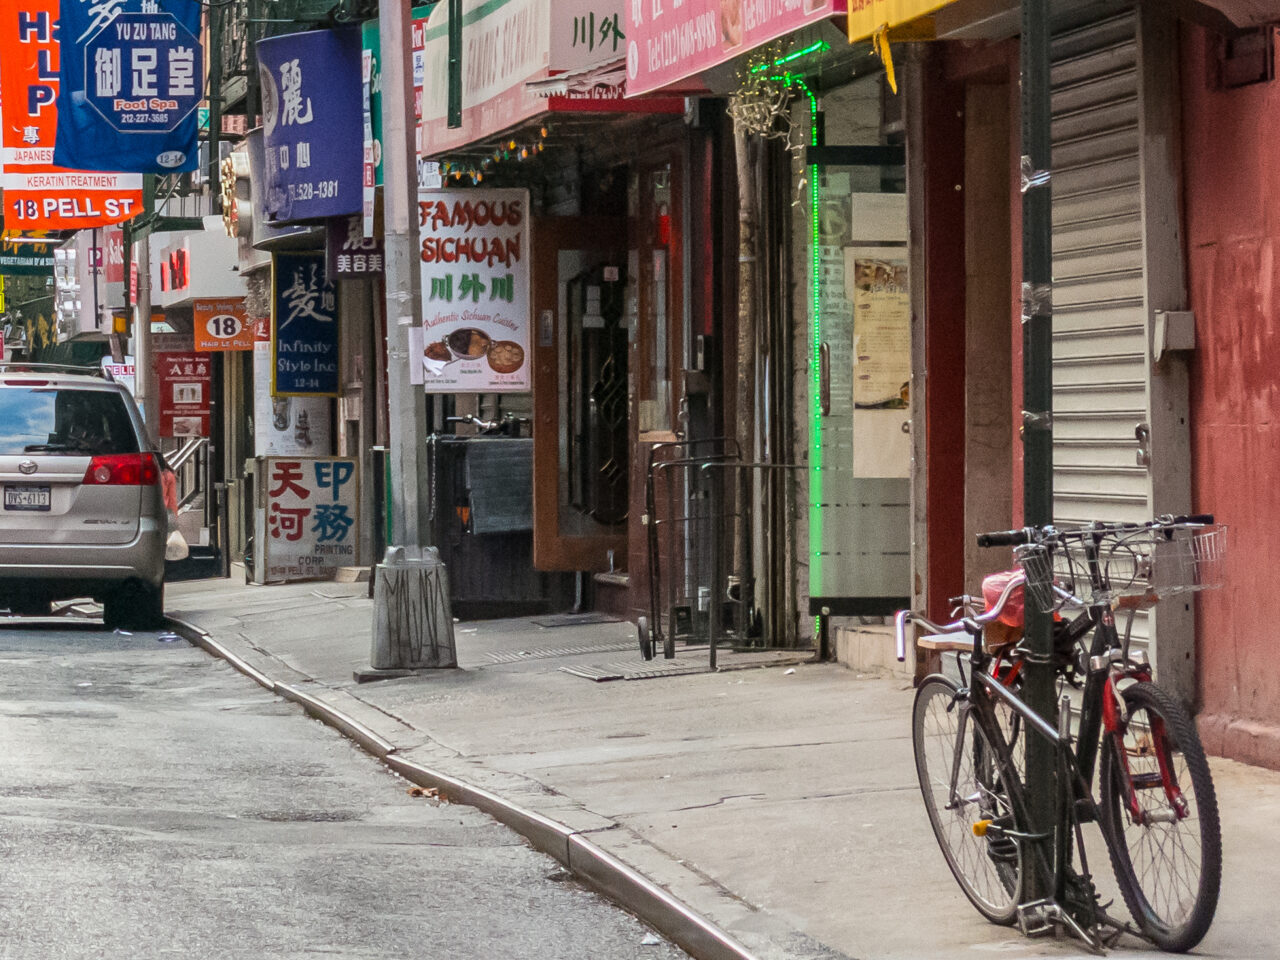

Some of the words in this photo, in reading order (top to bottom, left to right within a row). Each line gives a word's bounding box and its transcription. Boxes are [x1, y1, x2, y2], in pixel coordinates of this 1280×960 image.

[116, 23, 131, 40] YU
[133, 23, 147, 40] ZU
[150, 23, 176, 40] TANG
[95, 46, 195, 97] 御足堂
[114, 99, 145, 111] Foot
[149, 98, 178, 112] Spa
[27, 176, 64, 187] KERATIN
[66, 176, 118, 187] TREATMENT
[43, 198, 101, 218] PELL
[105, 198, 135, 217] ST
[419, 199, 521, 233] FAMOUS
[421, 233, 520, 269] SICHUAN
[429, 273, 514, 303] 川外川
[212, 317, 237, 336] 18
[278, 339, 331, 354] Infinity
[105, 365, 134, 375] ELL
[278, 357, 311, 372] Style
[269, 461, 311, 542] 天河
[314, 544, 353, 555] PRINTING
[298, 556, 325, 566] CORP
